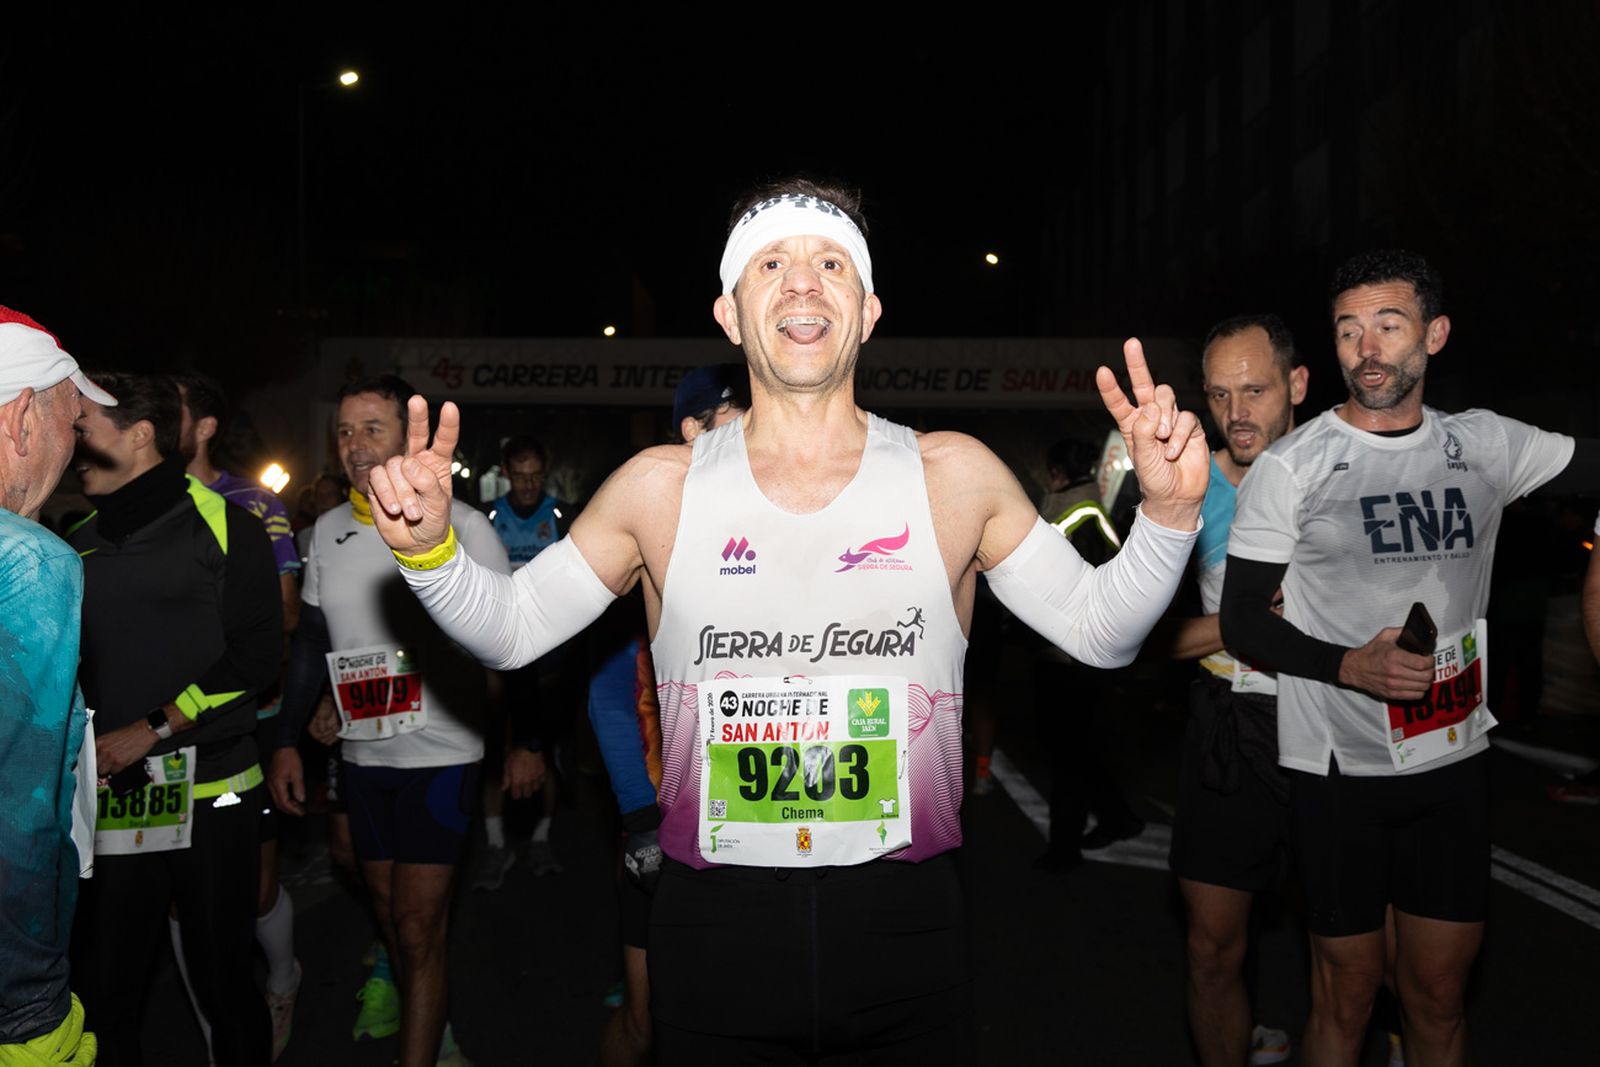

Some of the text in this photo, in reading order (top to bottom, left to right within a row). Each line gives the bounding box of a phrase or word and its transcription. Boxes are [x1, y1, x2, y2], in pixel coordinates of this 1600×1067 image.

[431, 358, 464, 390] 43
[473, 364, 598, 388] CARRERA
[860, 367, 952, 391] NOCHE
[955, 367, 991, 391] DE
[1000, 367, 1058, 391] SAN
[1360, 488, 1474, 554] ENA
[720, 564, 757, 575] mobel
[1374, 554, 1442, 564] ENTRENAMIENTO
[1450, 552, 1470, 560] SALUD
[694, 622, 915, 665] SIERRA DE SEGURA
[1445, 648, 1457, 662] DE
[350, 678, 406, 709] 9409
[721, 697, 737, 709] 43
[742, 699, 802, 717] NOCHE
[722, 718, 830, 742] SAN ANTÓN
[737, 744, 869, 801] 9203
[98, 784, 181, 819] 13885
[781, 807, 824, 820] Chema
